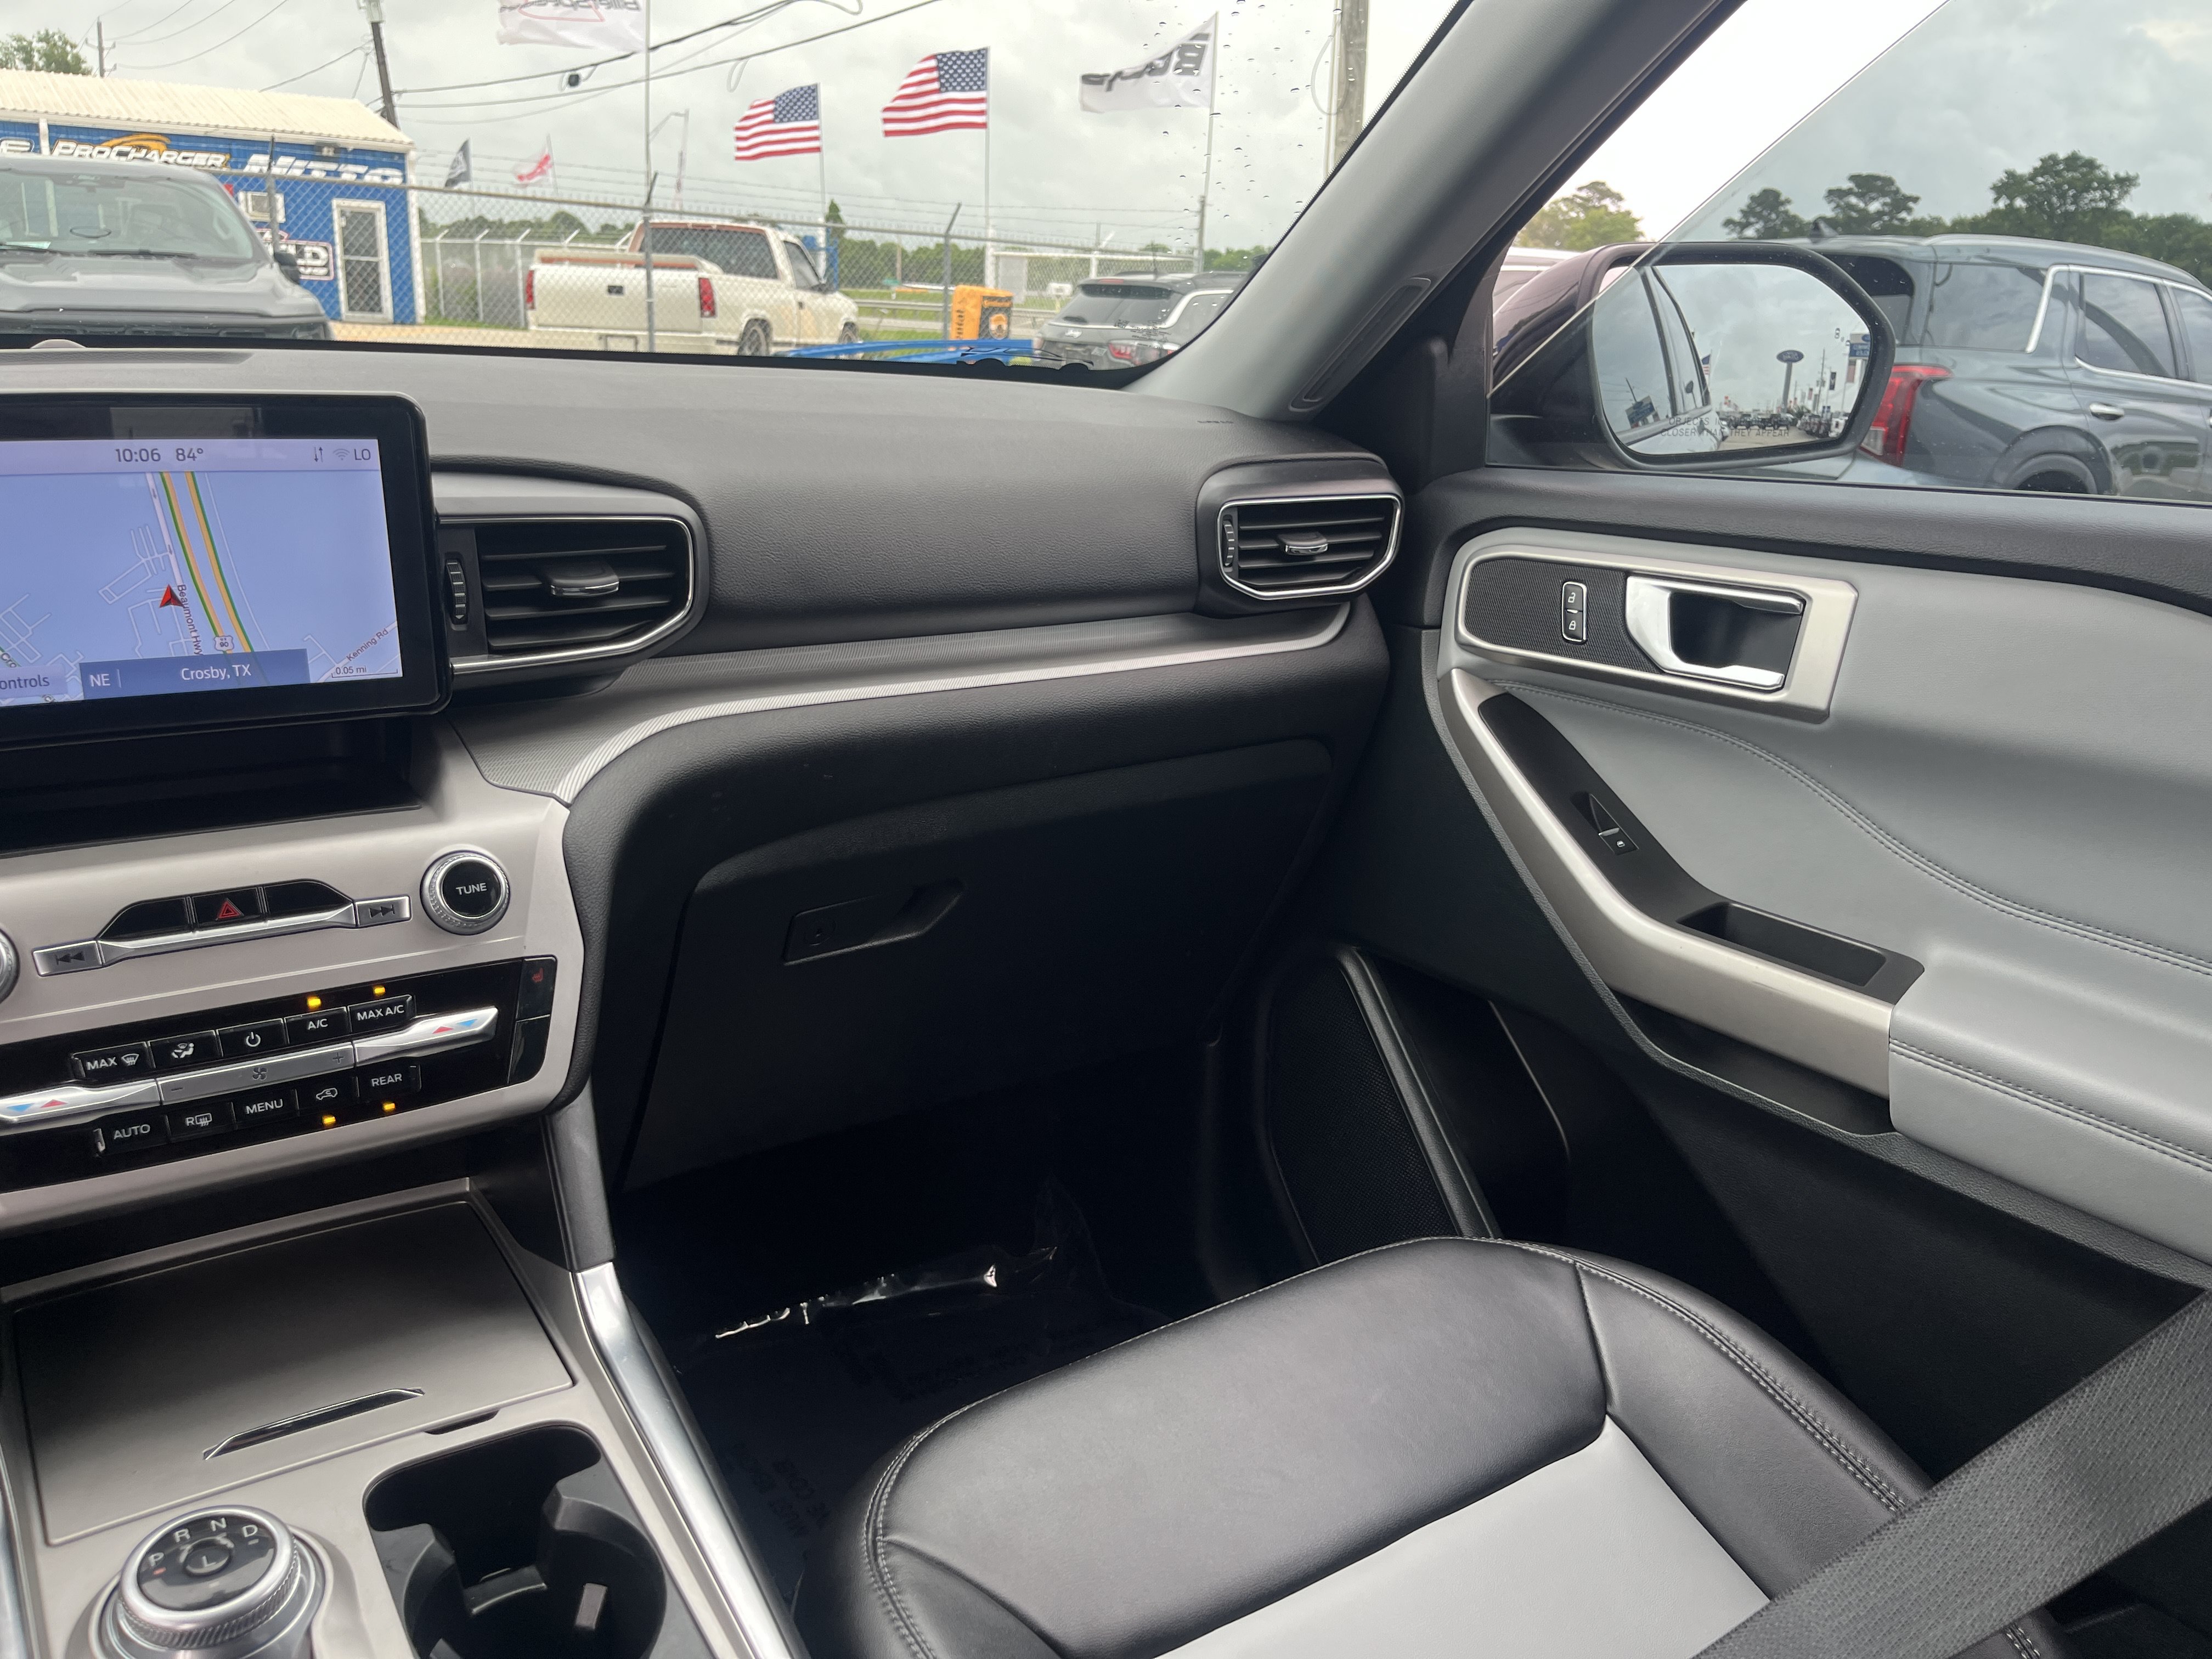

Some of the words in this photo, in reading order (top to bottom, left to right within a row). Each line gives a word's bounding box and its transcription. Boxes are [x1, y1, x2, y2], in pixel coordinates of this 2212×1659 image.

[115, 448, 161, 462] 10:06
[176, 448, 204, 462] 84°
[354, 448, 371, 461] LO
[177, 584, 198, 633] Beaumont
[191, 635, 204, 656] Hwy
[346, 638, 377, 661] Kenning
[376, 628, 389, 640] Rd
[182, 666, 230, 680] Crosby,
[232, 664, 251, 676] TX
[336, 667, 354, 675] 0.05
[89, 674, 111, 687] NE
[455, 882, 487, 895] TUNE
[357, 1008, 383, 1020] MAX
[385, 1005, 405, 1015] A/C
[308, 1018, 329, 1030] A/C
[86, 1057, 118, 1070] MAX
[371, 1073, 403, 1087] REAR
[246, 1099, 284, 1114] MENU
[114, 1124, 150, 1139] AUTO
[210, 1517, 228, 1532] N
[242, 1525, 258, 1538] D
[173, 1528, 190, 1543] R
[148, 1552, 165, 1567] P
